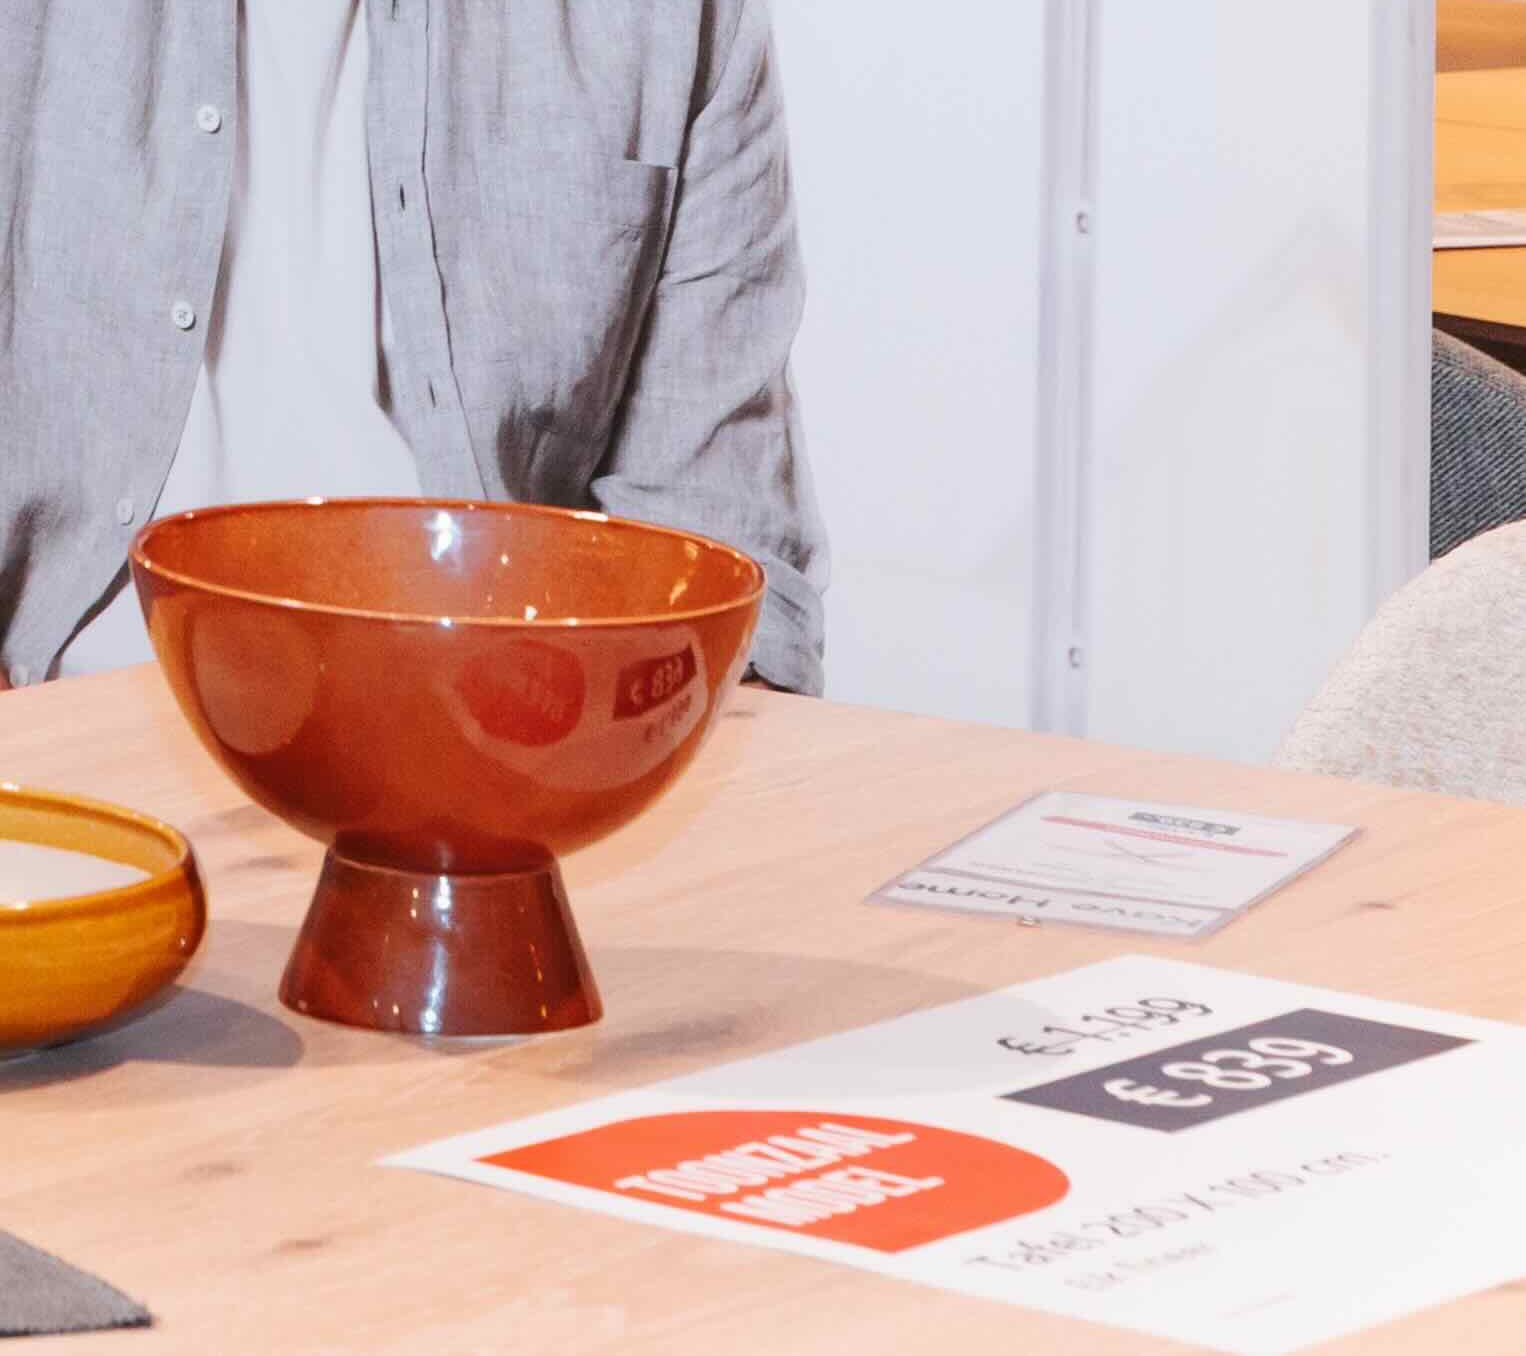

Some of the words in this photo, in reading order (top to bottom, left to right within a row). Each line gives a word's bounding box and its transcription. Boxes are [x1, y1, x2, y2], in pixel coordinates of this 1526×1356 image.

[896, 881, 1051, 909] Home
[1103, 1078, 1214, 1109] €
[1160, 1036, 1354, 1091] 839
